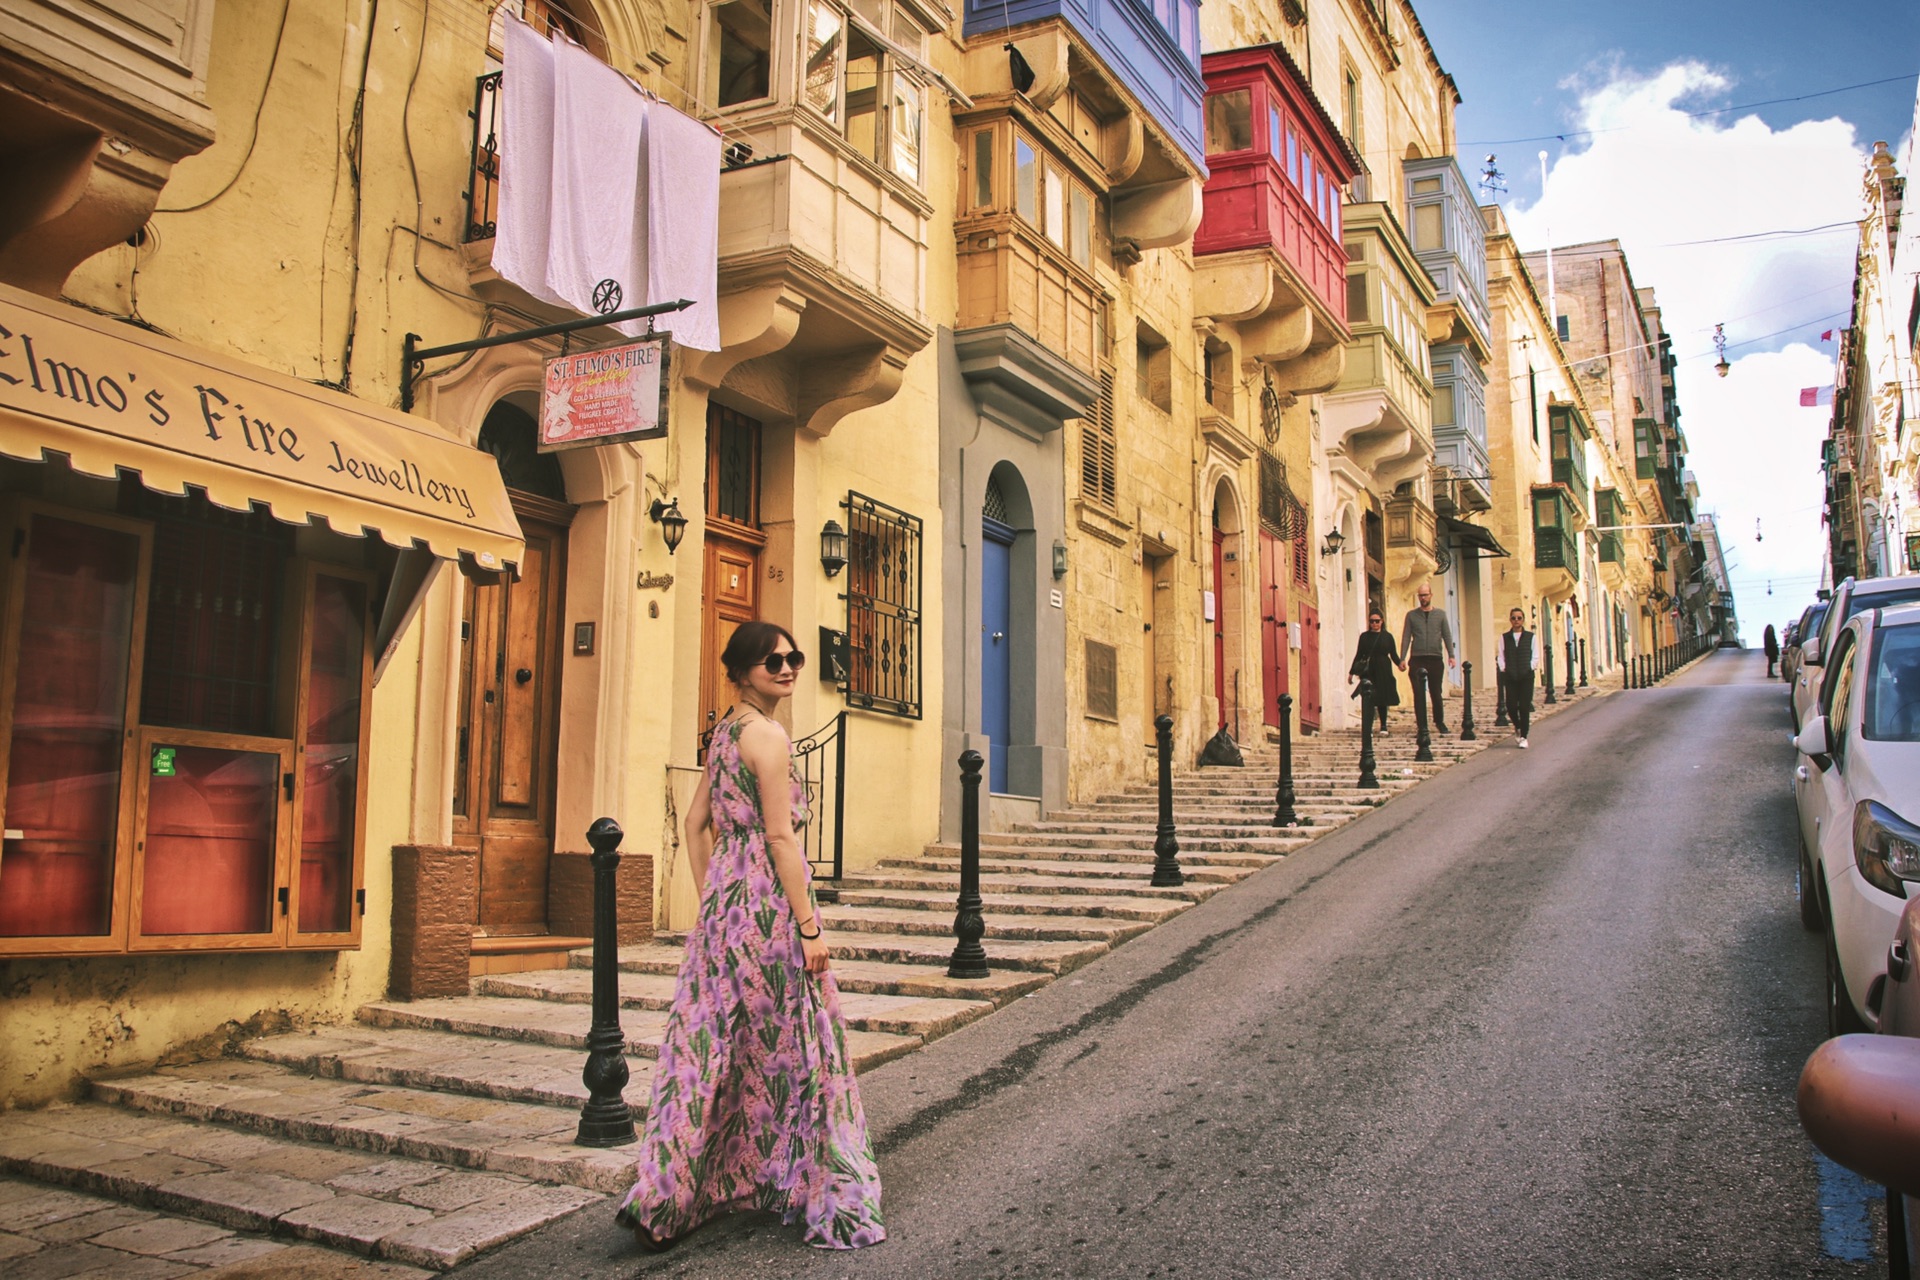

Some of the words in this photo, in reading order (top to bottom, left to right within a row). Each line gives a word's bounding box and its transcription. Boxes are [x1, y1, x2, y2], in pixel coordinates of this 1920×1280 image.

[553, 362, 571, 380] ST.
[575, 352, 621, 376] ELMO'S
[625, 347, 654, 368] FIRE
[573, 394, 588, 403] GOLD
[584, 402, 601, 410] HAND
[601, 400, 618, 408] MADE
[603, 406, 623, 416] CRAFTS
[193, 384, 305, 462] Fire
[327, 440, 476, 519] Jewellery
[157, 760, 170, 768] Free
